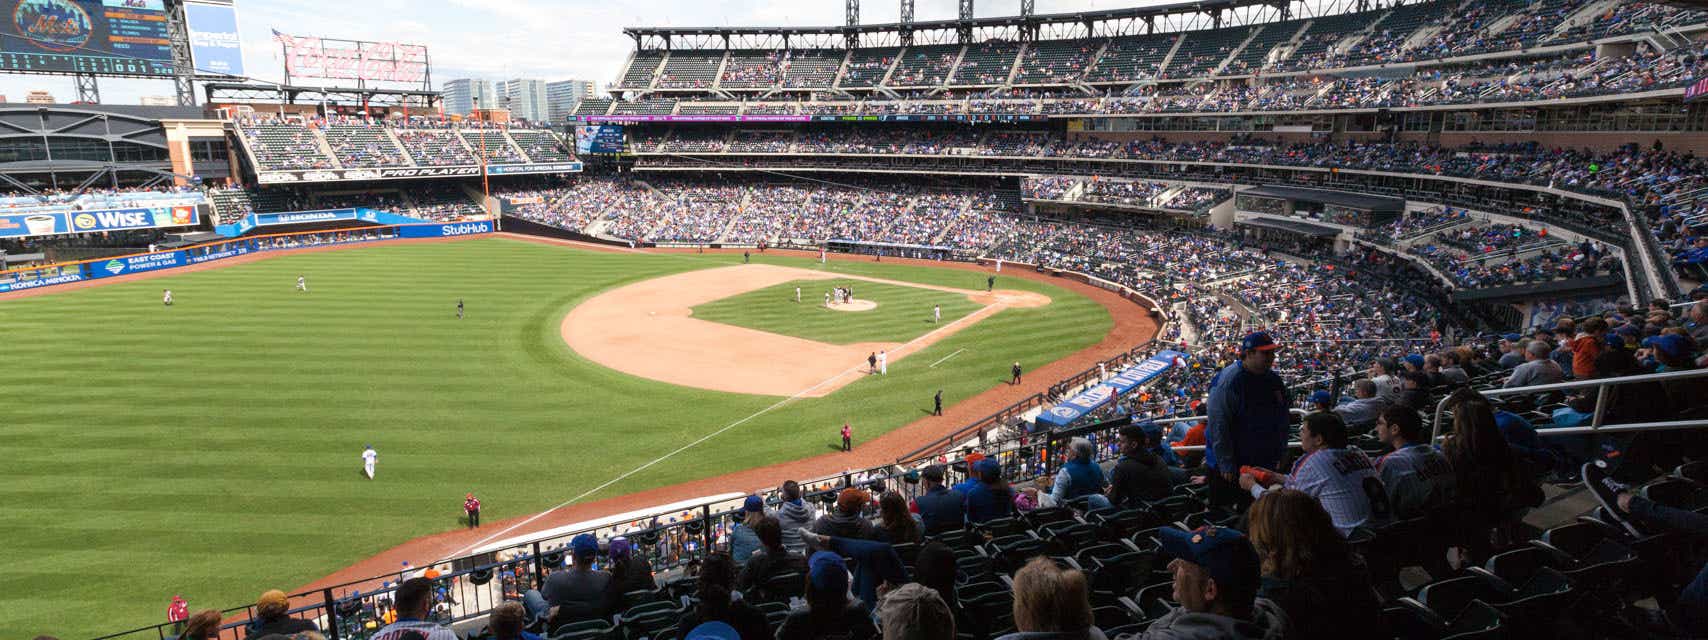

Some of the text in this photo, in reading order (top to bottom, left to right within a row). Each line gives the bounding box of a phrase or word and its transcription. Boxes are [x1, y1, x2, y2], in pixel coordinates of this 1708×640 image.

[381, 169, 418, 177] PRO
[418, 167, 479, 176] PLAYER
[289, 212, 337, 220] HONDA
[442, 222, 488, 236] StubHub
[128, 252, 175, 264] EAST COAST
[129, 261, 156, 270] POWER
[10, 274, 81, 290] KONICA MINOLTA
